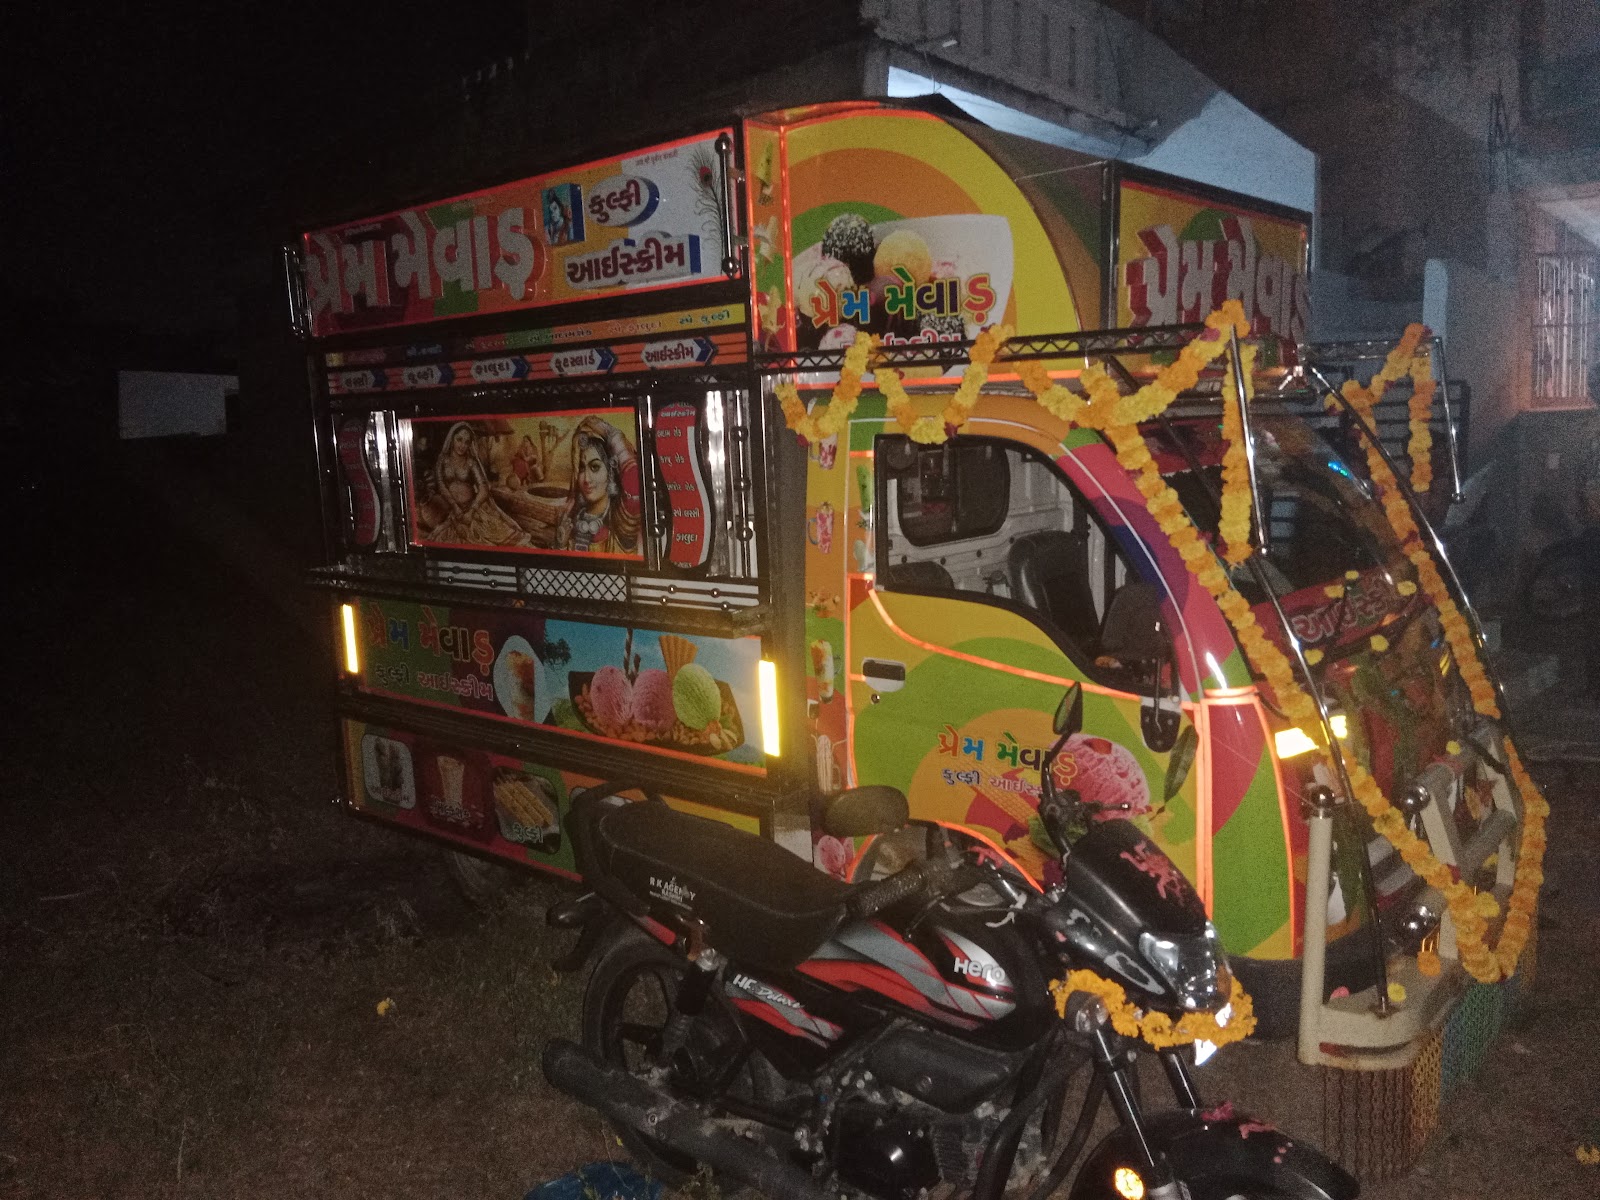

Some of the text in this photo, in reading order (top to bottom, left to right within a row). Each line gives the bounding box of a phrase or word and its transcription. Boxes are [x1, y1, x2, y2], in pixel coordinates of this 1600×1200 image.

[588, 179, 641, 223] કુલ્ફી
[810, 279, 871, 328] પ્રેમ
[937, 724, 984, 761] પ્રેમ
[953, 956, 1006, 984] Hero
